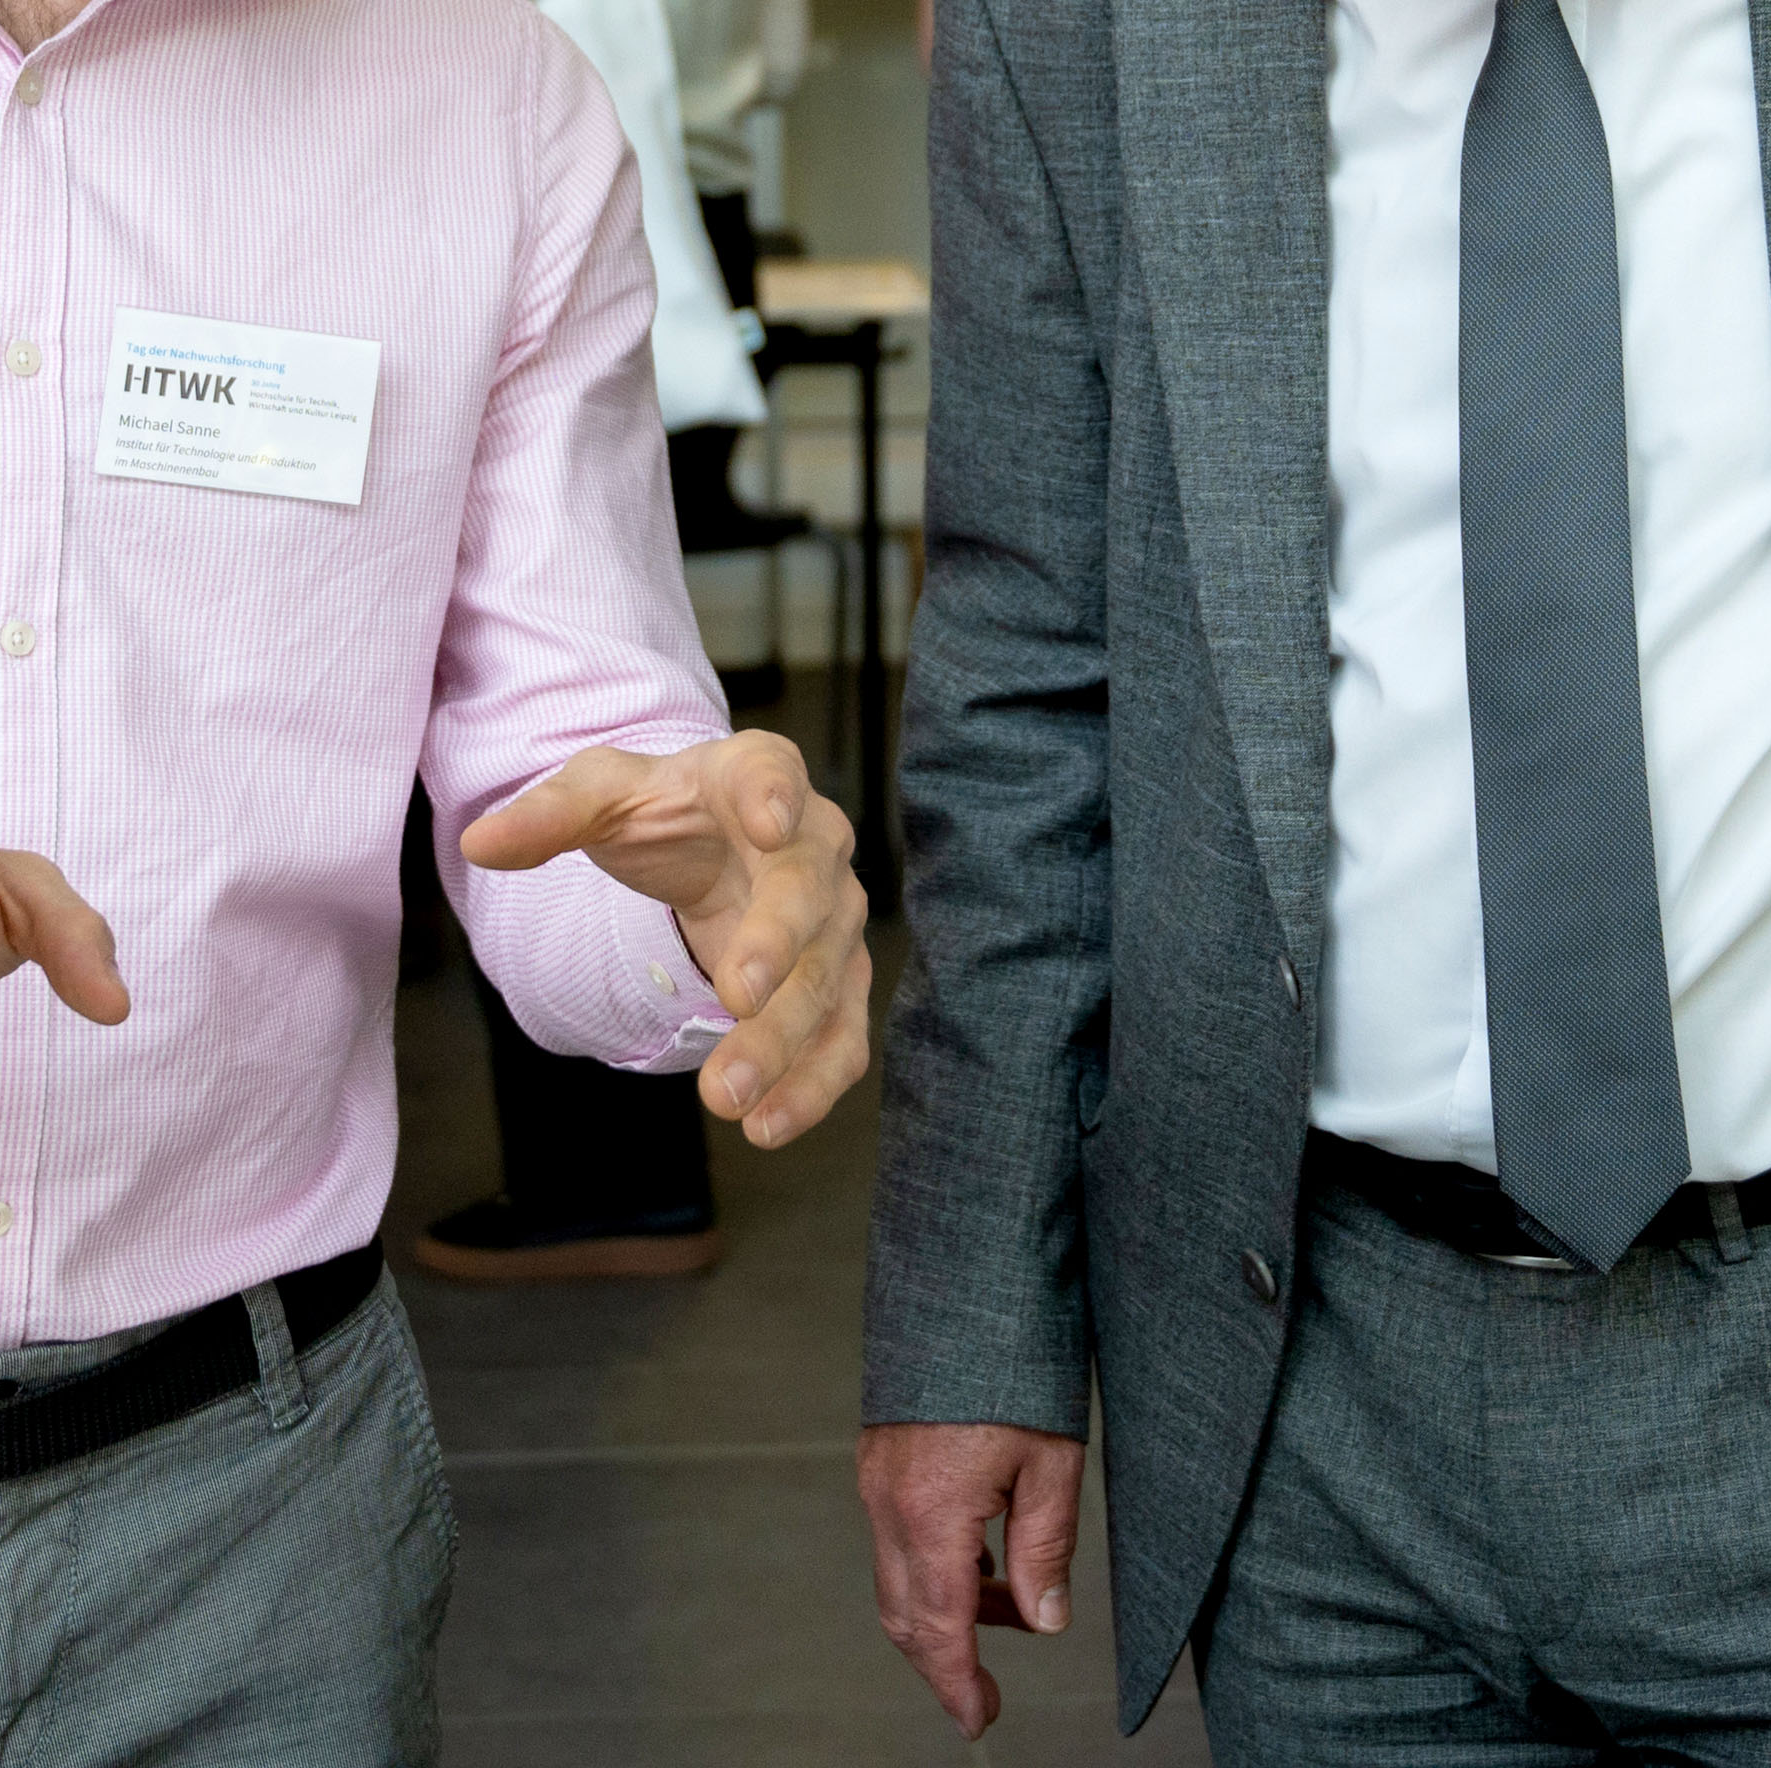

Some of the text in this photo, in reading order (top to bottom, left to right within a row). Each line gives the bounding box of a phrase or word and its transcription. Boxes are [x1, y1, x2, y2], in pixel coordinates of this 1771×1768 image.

[126, 343, 286, 374] Tag der Nachwuchsforschung
[124, 363, 237, 405] HTWK
[250, 390, 294, 403] Hochschule
[249, 401, 287, 413] Wirtschaft
[288, 405, 303, 415] und
[330, 409, 357, 423] Leipzig
[119, 414, 221, 438] Michael Sanne
[114, 457, 128, 468] im
[116, 438, 316, 471] Institut für Technologie und Produktion
